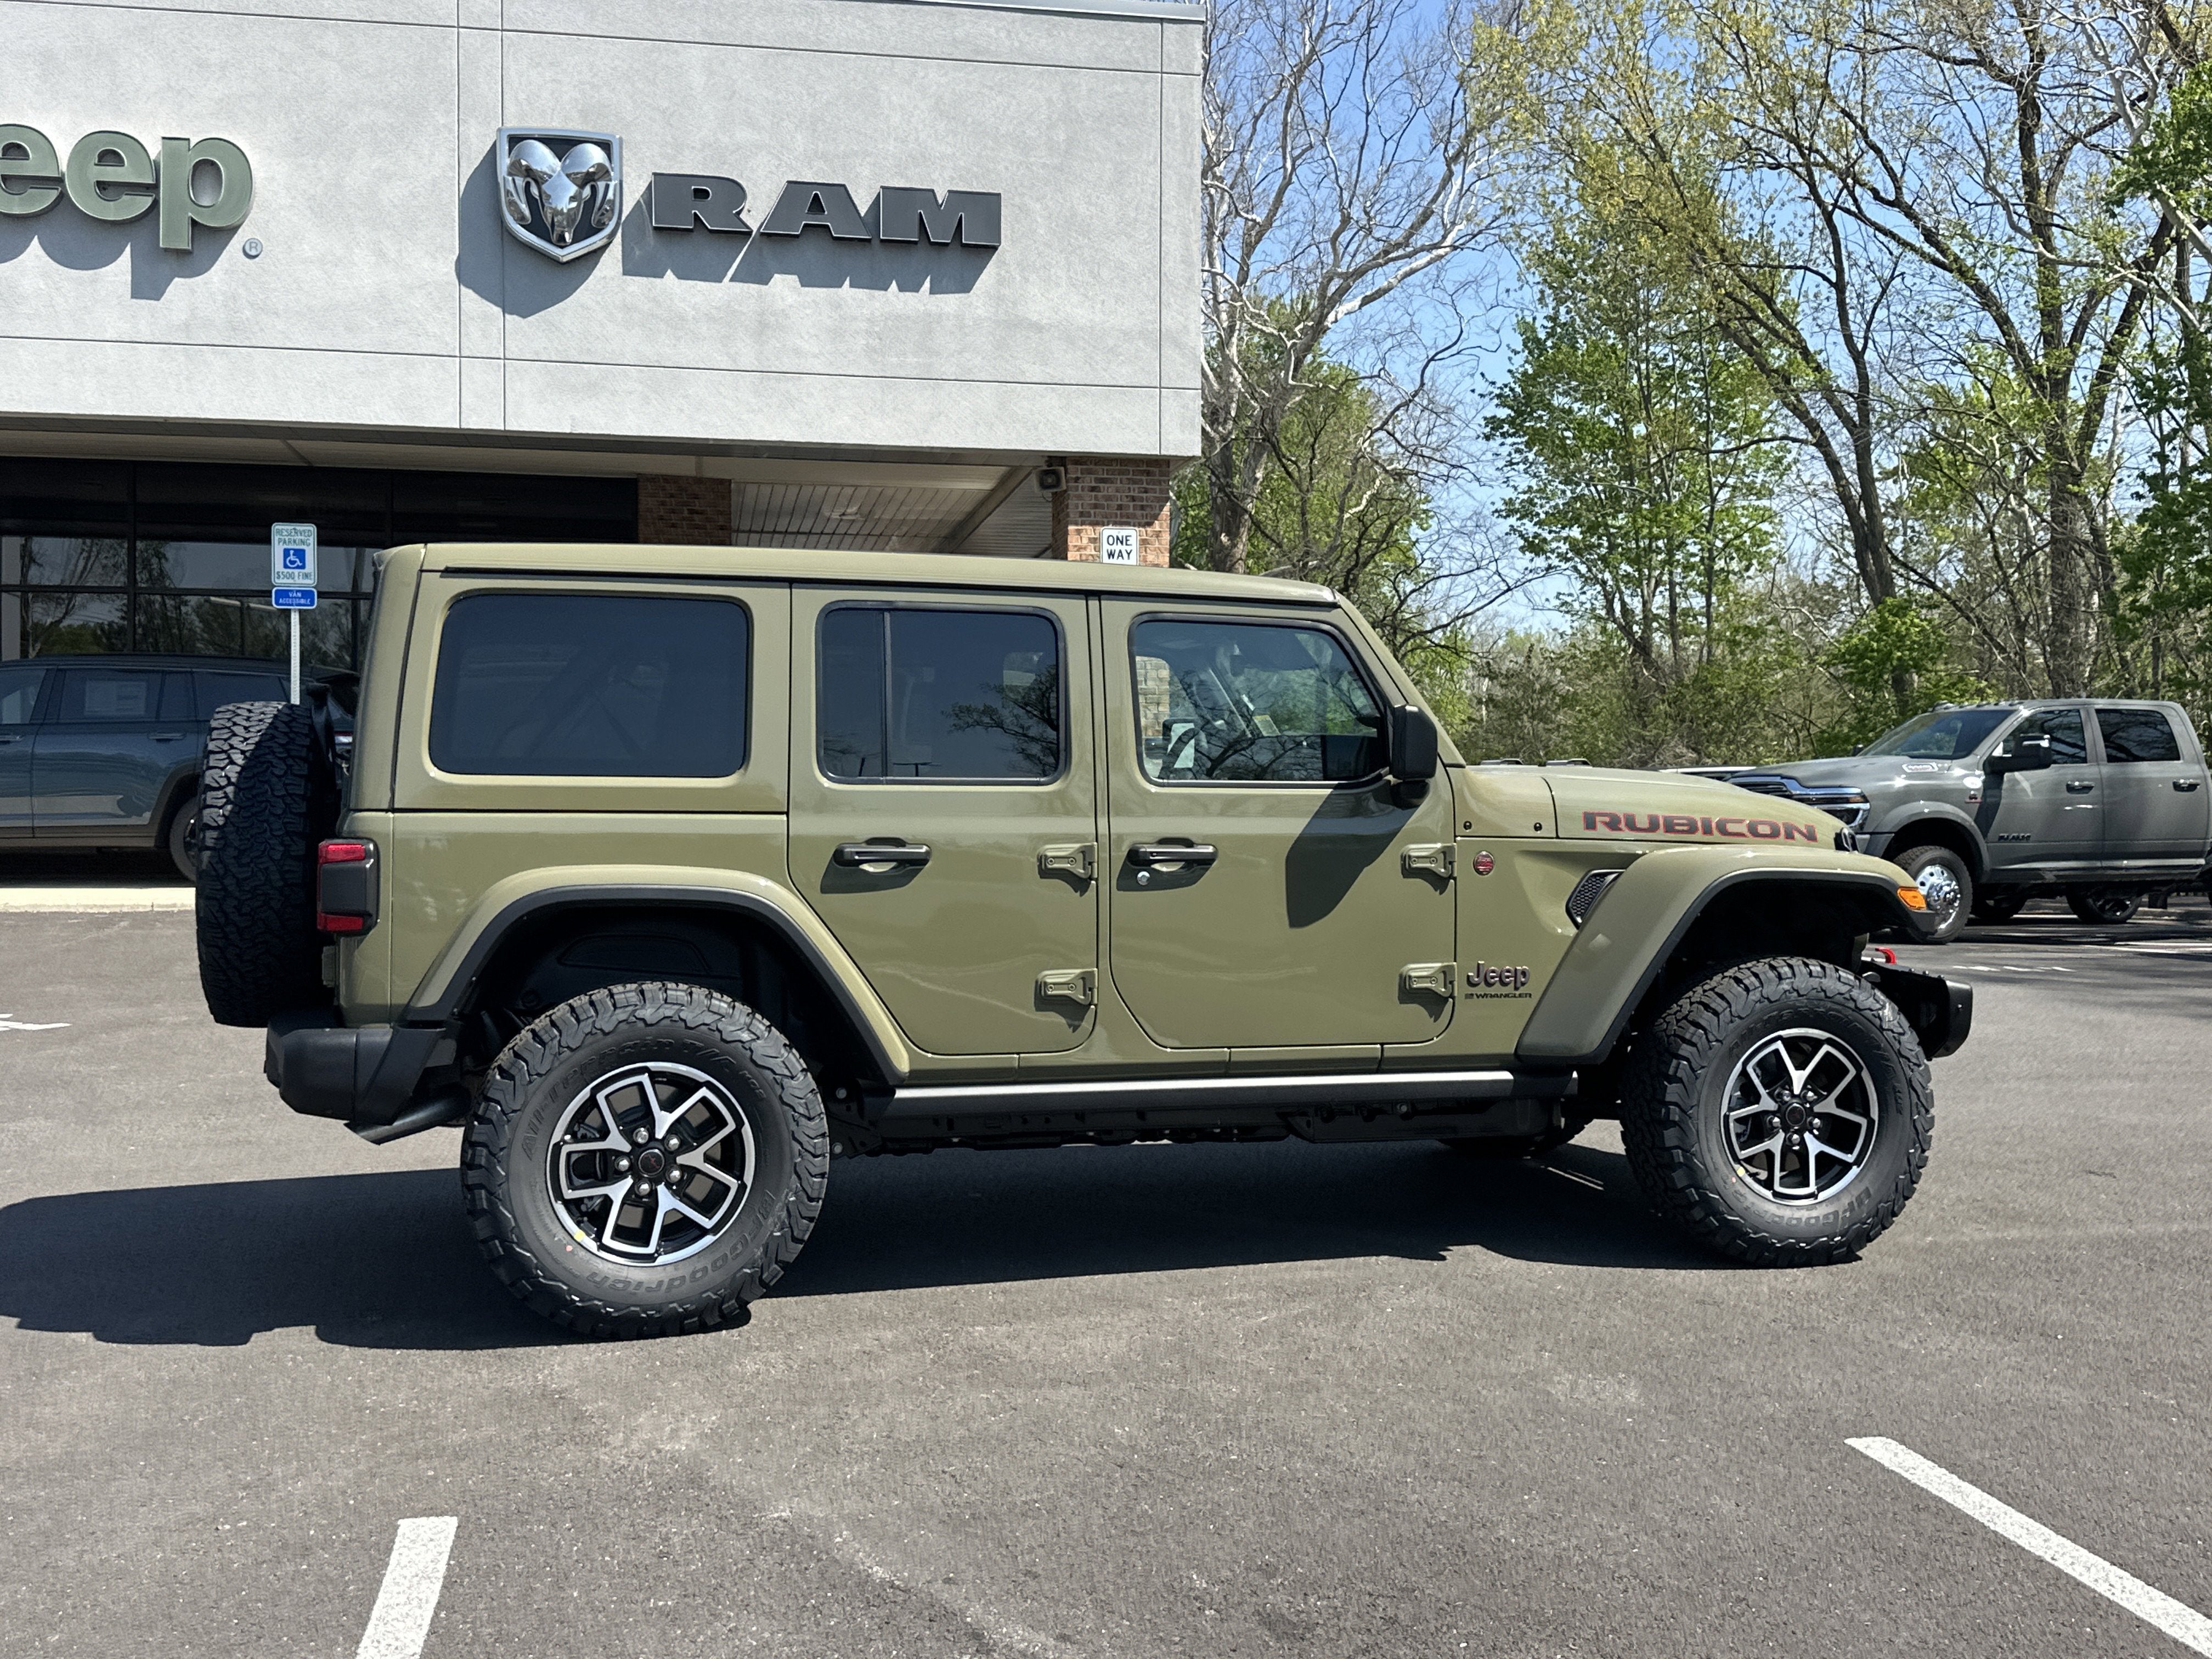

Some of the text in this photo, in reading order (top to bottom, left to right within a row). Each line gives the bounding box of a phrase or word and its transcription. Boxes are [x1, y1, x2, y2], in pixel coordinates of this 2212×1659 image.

[651, 172, 1002, 247] RAM
[275, 528, 313, 538] RESERVED
[278, 537, 311, 547] PARKING
[1107, 535, 1132, 546] ONE
[1107, 549, 1133, 560] WAY
[276, 571, 313, 580] $500 FINE
[1582, 811, 1819, 843] RUBICON
[1466, 961, 1530, 991] Jeep
